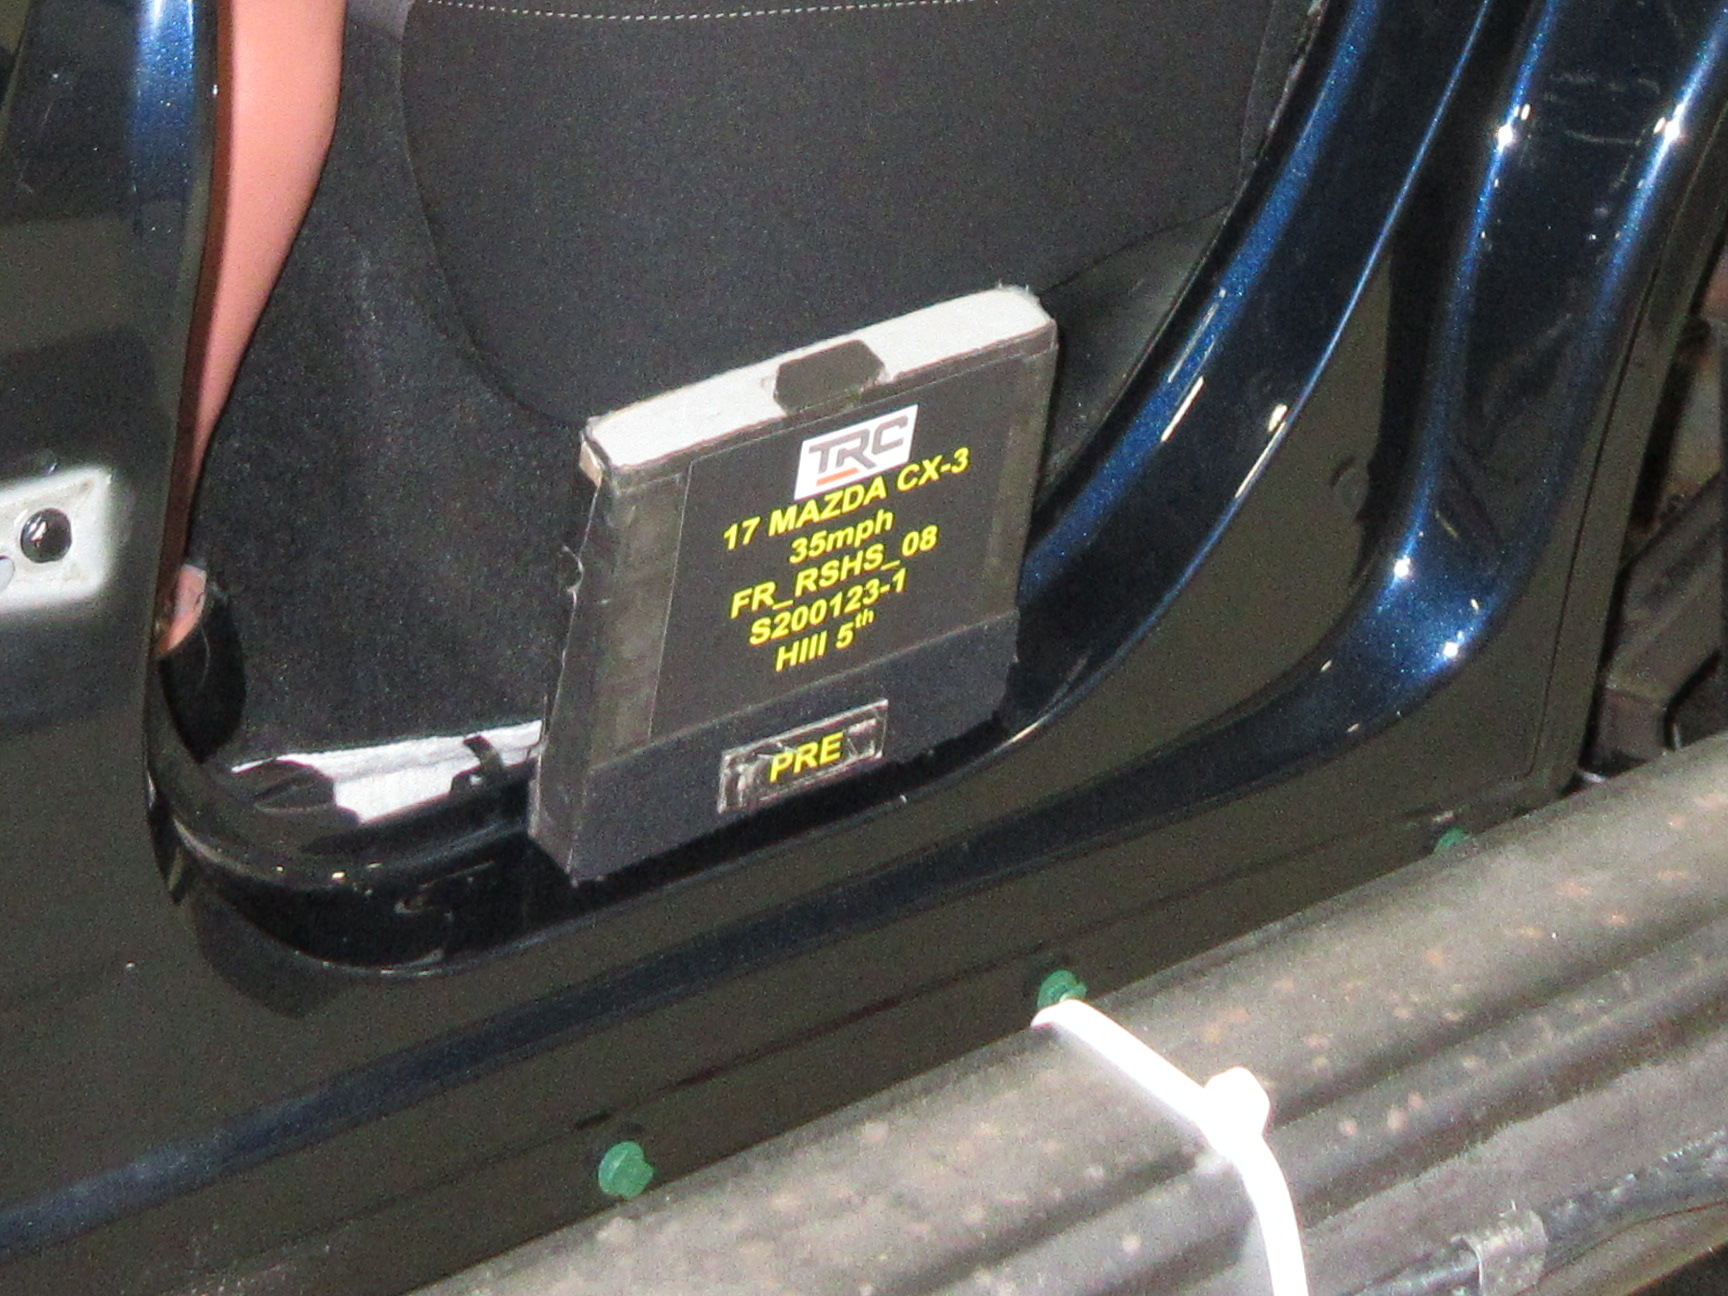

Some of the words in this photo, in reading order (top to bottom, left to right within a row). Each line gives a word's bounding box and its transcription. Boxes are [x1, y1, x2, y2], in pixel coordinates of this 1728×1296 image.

[808, 415, 909, 474] TRC
[723, 516, 761, 551] 17
[768, 476, 888, 537] MAZDA
[896, 447, 970, 492] CX-3
[789, 509, 894, 564] 35mph
[731, 524, 939, 620] FR_RSHS_08
[749, 567, 907, 646] S200123-1
[835, 608, 876, 650] 5th
[770, 730, 845, 783] PRE
